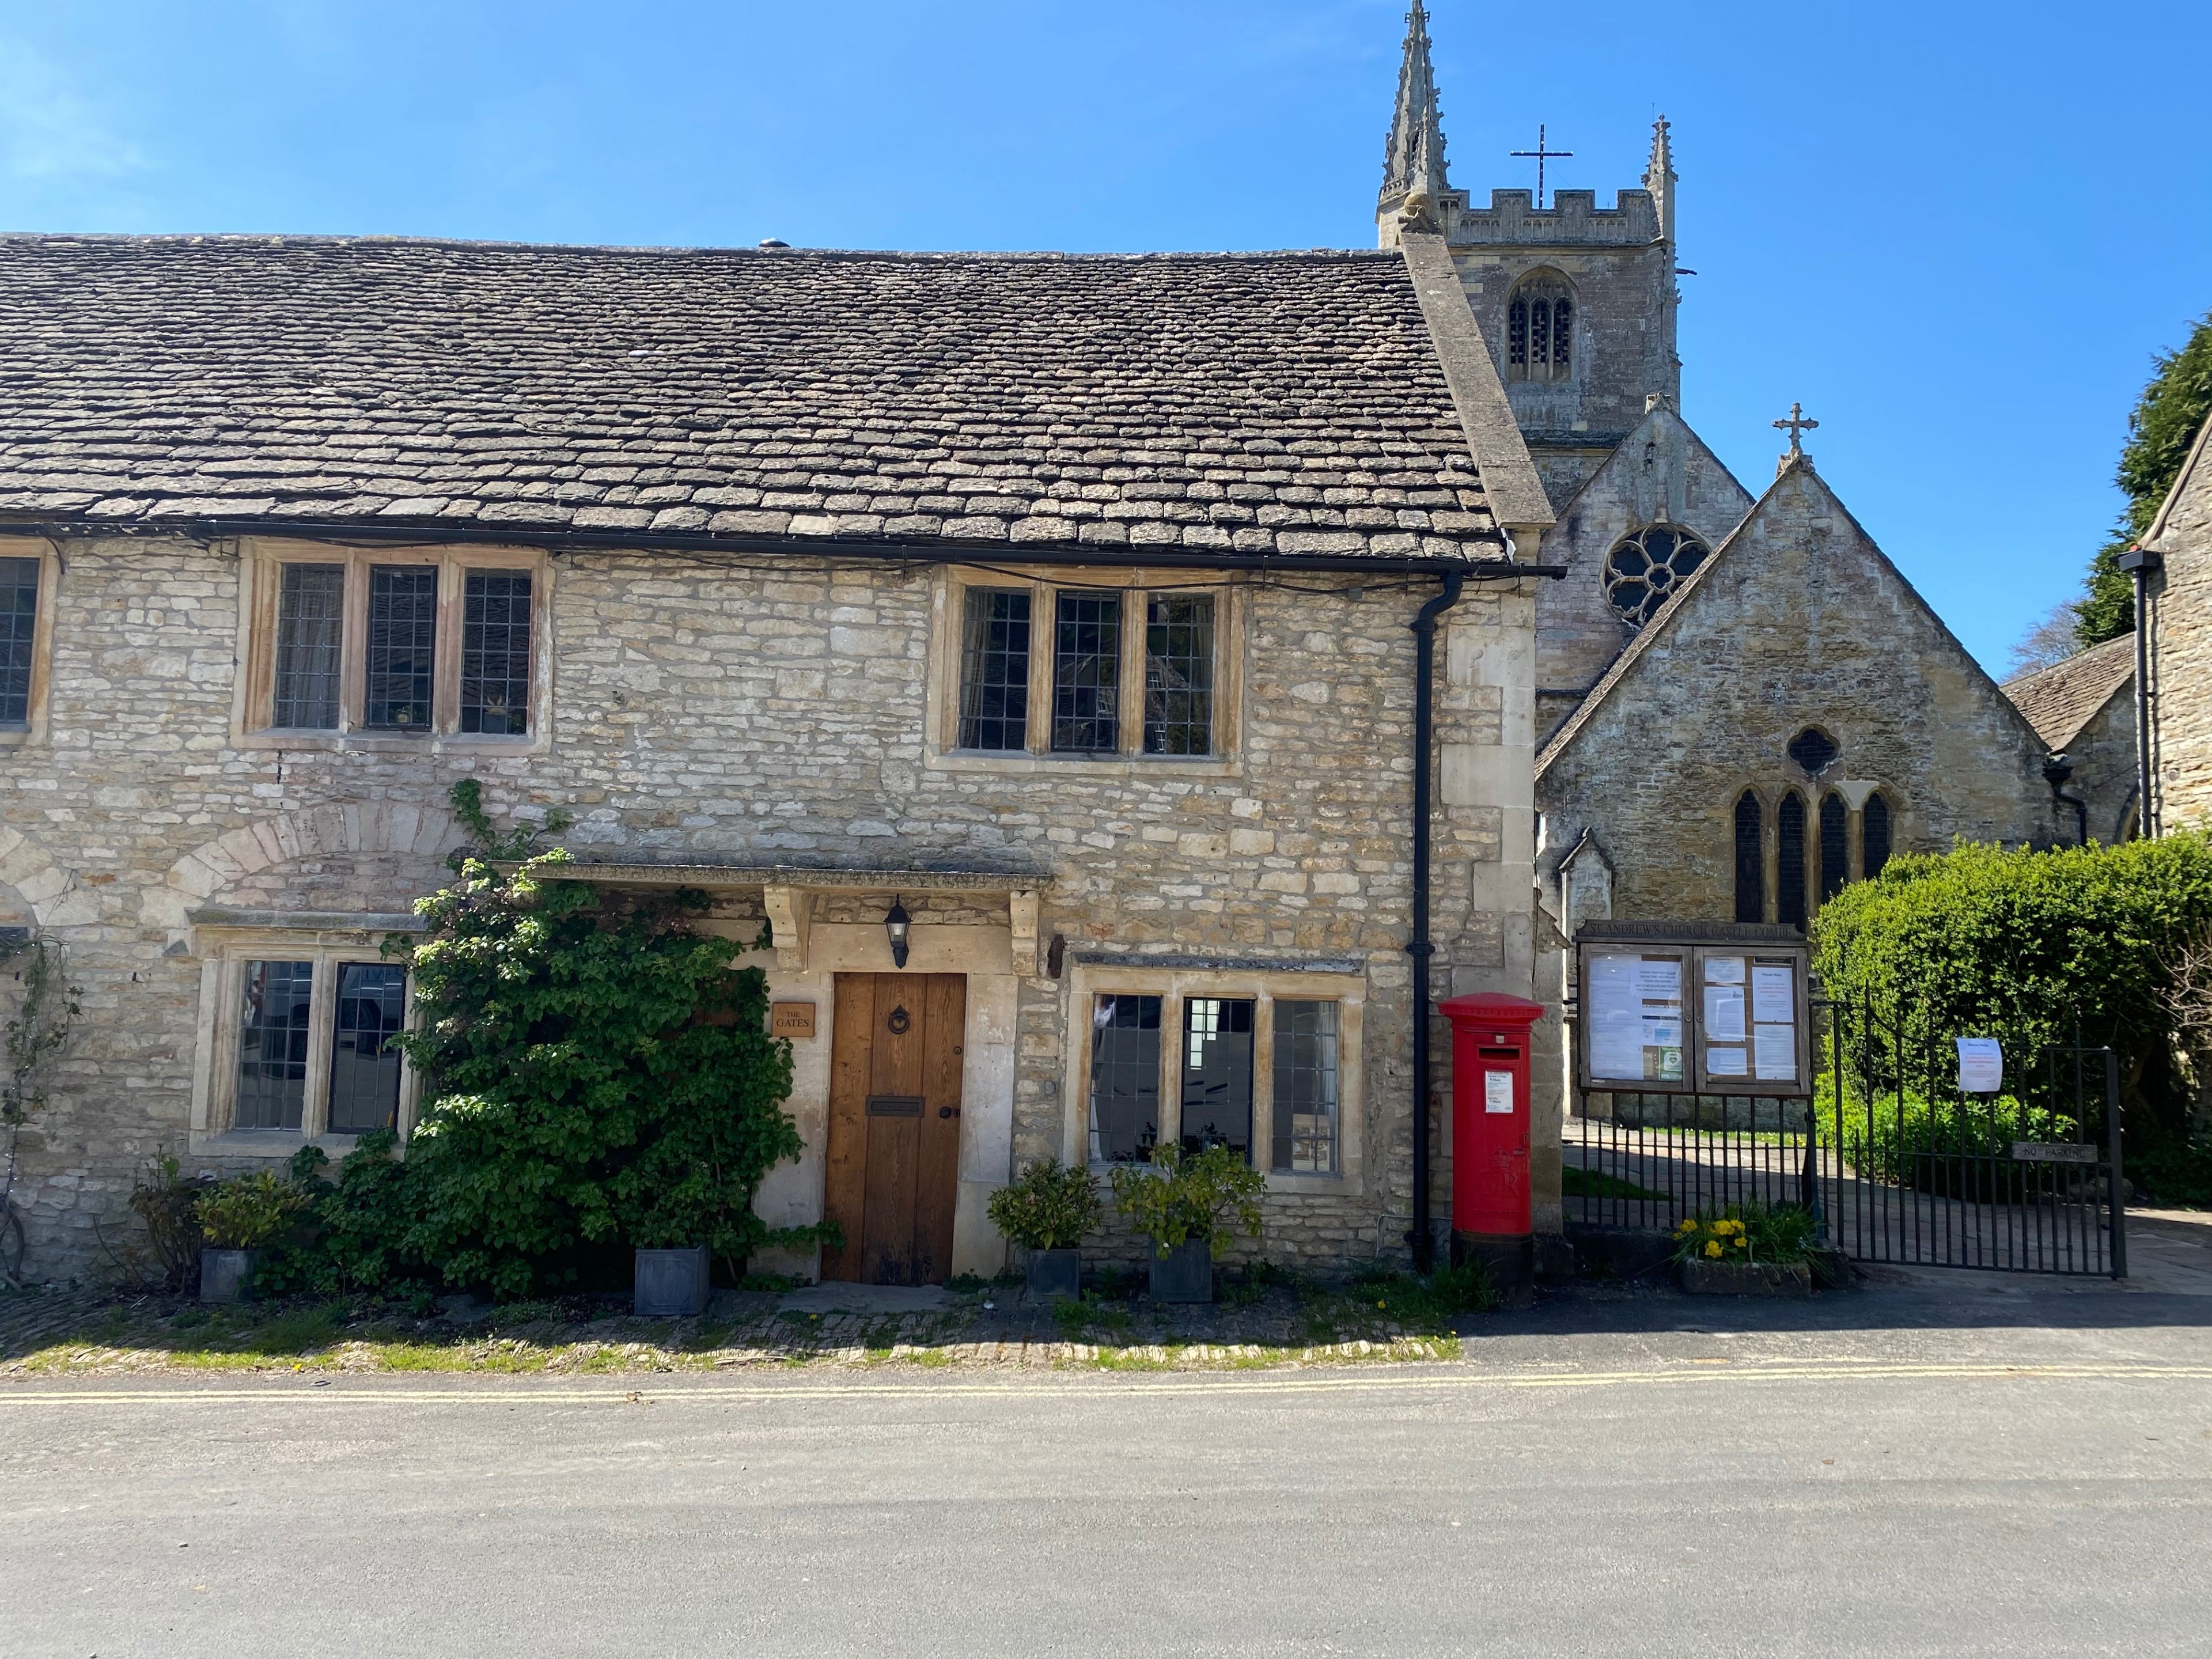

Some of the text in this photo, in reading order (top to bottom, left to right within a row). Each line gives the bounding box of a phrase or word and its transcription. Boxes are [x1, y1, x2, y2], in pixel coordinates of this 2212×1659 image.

[1607, 924, 1660, 935] ANDREW'S
[1664, 925, 1707, 936] CHURCH
[1711, 926, 1751, 937] CASTLE
[1755, 926, 1792, 938] COMBE
[776, 1019, 809, 1027] GATES
[2024, 1147, 2037, 1157] NO
